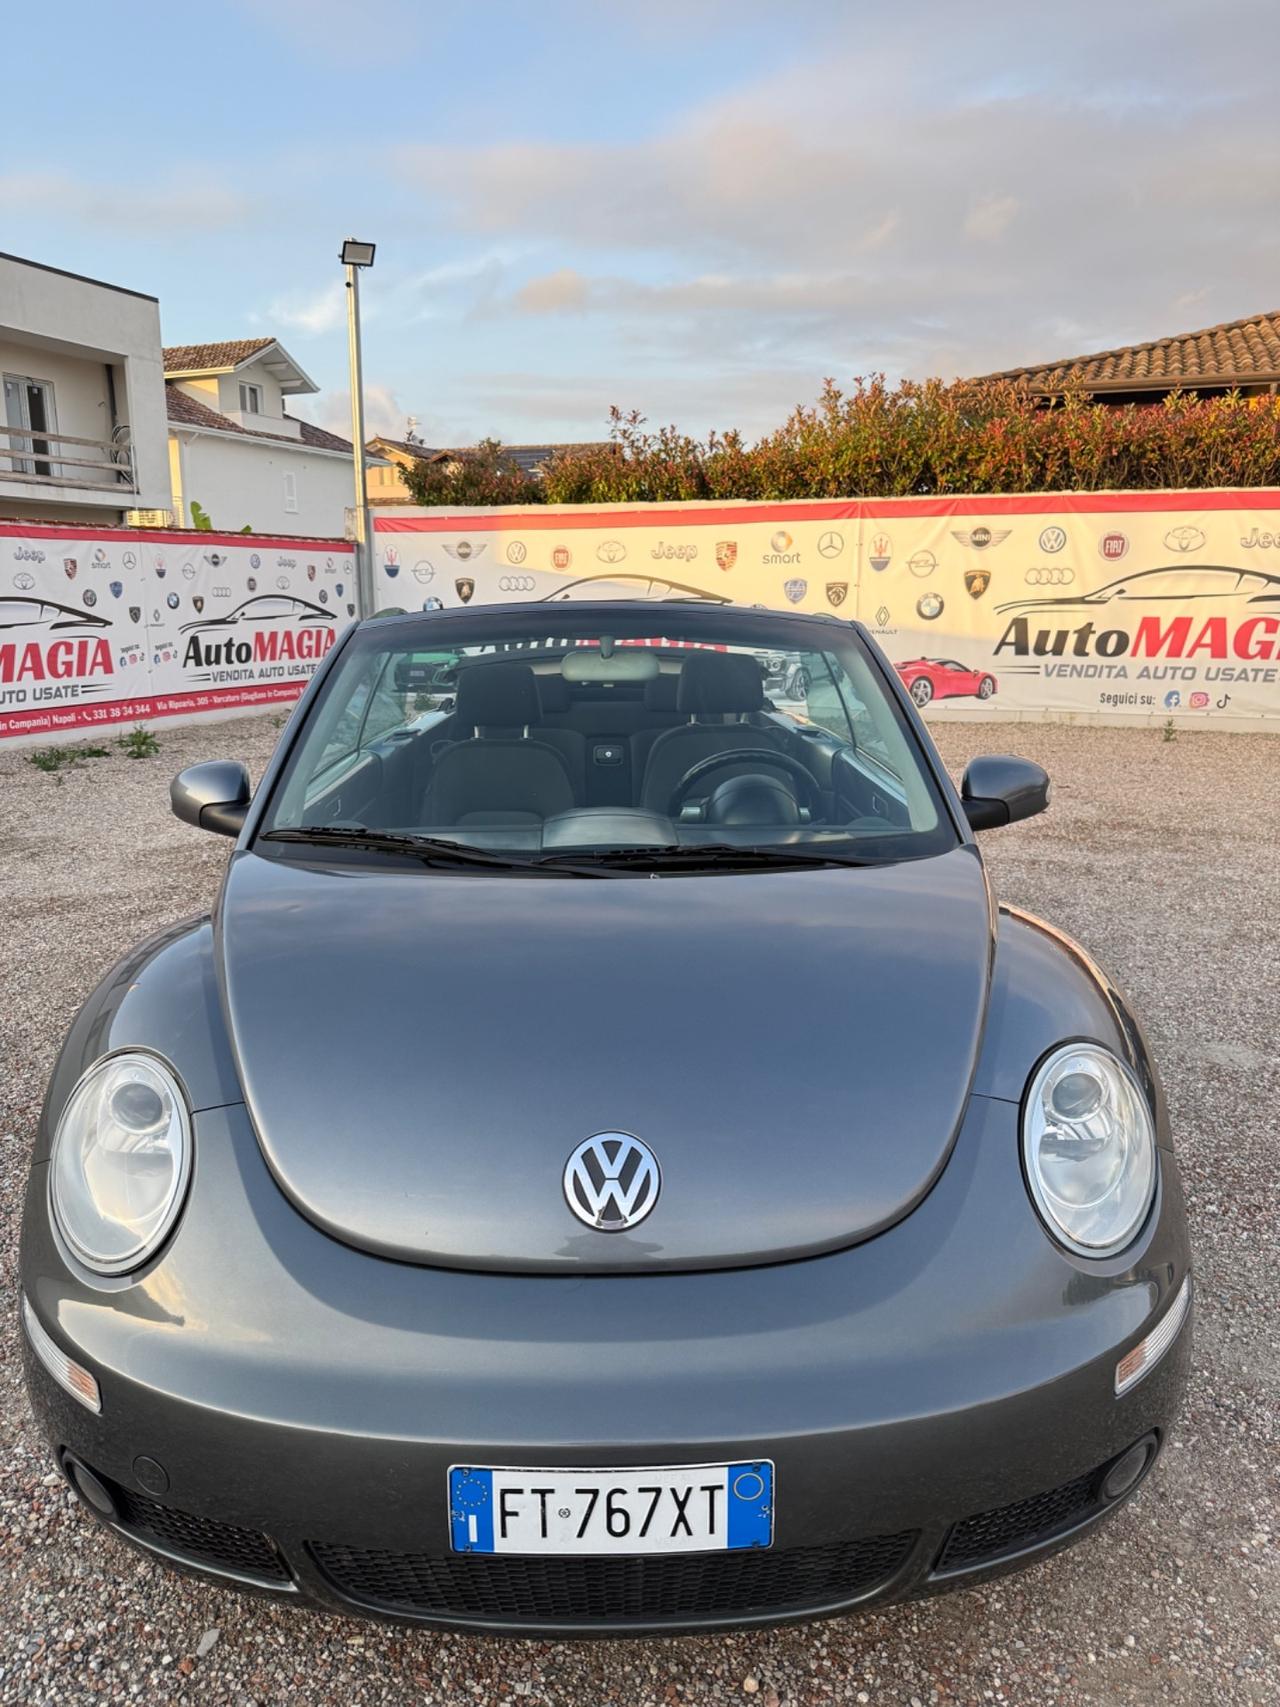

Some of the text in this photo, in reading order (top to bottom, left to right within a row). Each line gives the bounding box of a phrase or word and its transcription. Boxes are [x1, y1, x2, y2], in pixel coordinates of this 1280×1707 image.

[13, 546, 46, 564] Jeep
[650, 541, 698, 562] Jeep
[1105, 539, 1124, 554] FIAT
[762, 552, 801, 564] smart
[993, 616, 1280, 660] AutoMAG
[211, 664, 317, 682] VENDITA AUTO USATE
[1043, 663, 1279, 683] VENDITA AUTO USATE
[33, 684, 80, 701] USATE
[1099, 692, 1156, 707] Seguici su:
[9, 716, 51, 730] Campania)
[52, 712, 77, 725] Napoli
[92, 709, 108, 720] 331
[109, 707, 121, 718] 38
[122, 706, 133, 716] 34
[135, 704, 150, 714] 344
